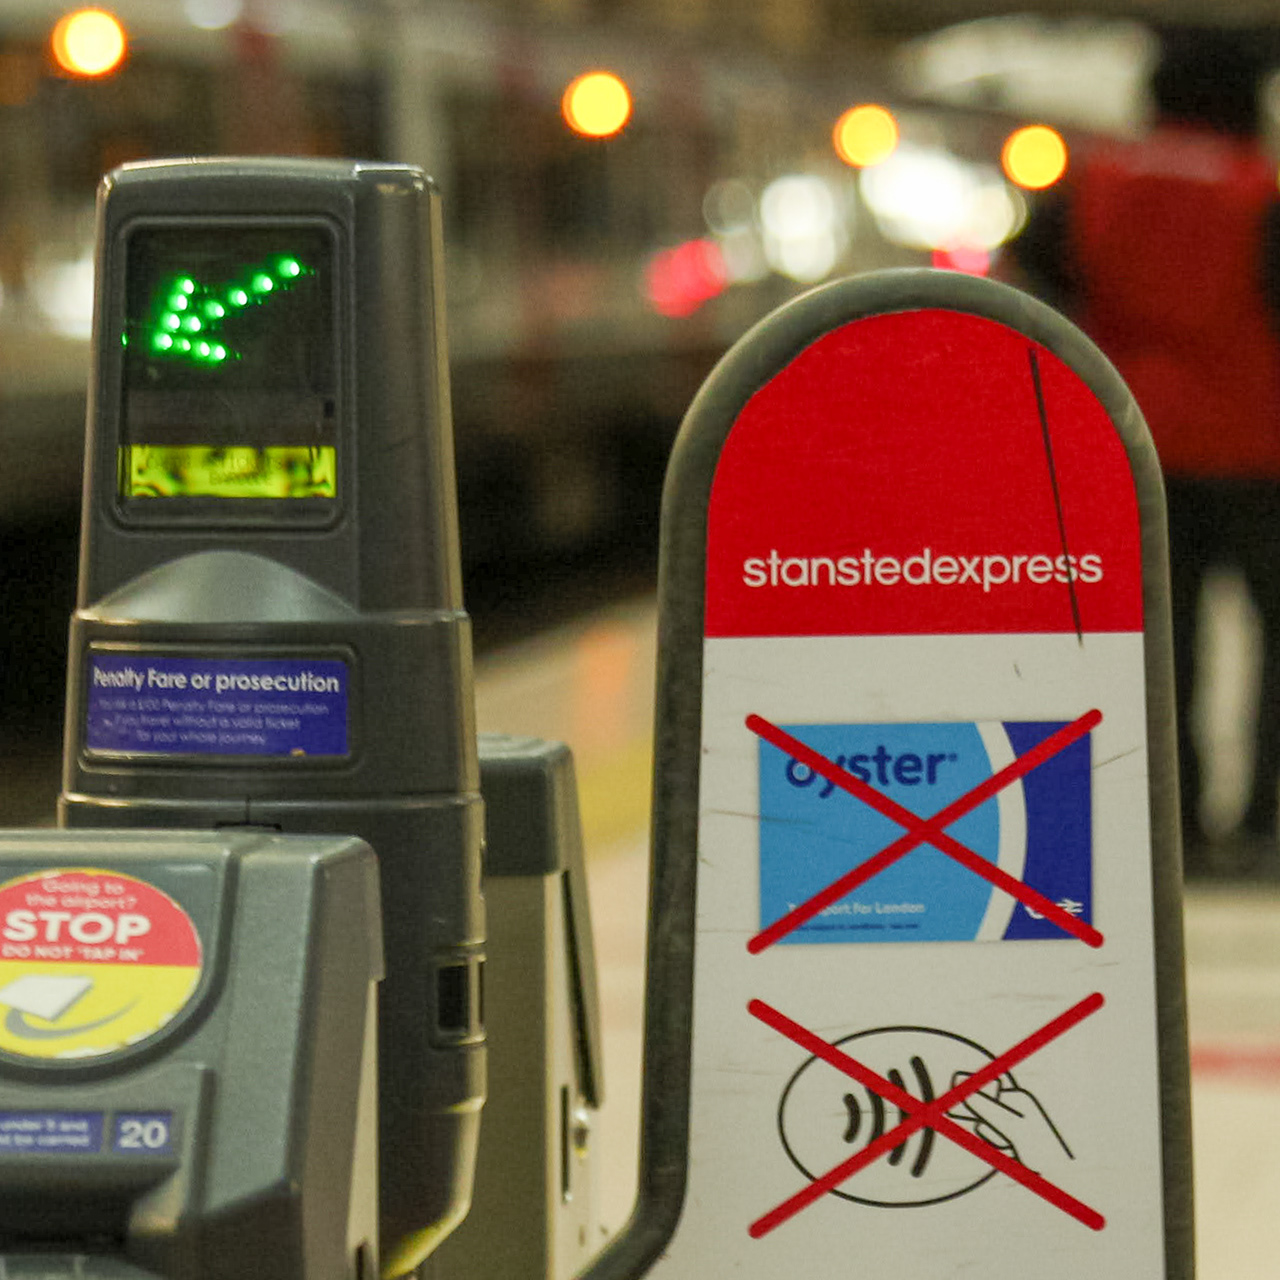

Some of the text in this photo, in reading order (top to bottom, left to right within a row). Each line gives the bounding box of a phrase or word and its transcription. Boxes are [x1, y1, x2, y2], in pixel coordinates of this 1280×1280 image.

[743, 547, 1103, 593] stanstedexpress
[93, 666, 340, 694] Penalty Fare or prosecution
[2, 909, 151, 945] STOP
[119, 1119, 167, 1148] 20
